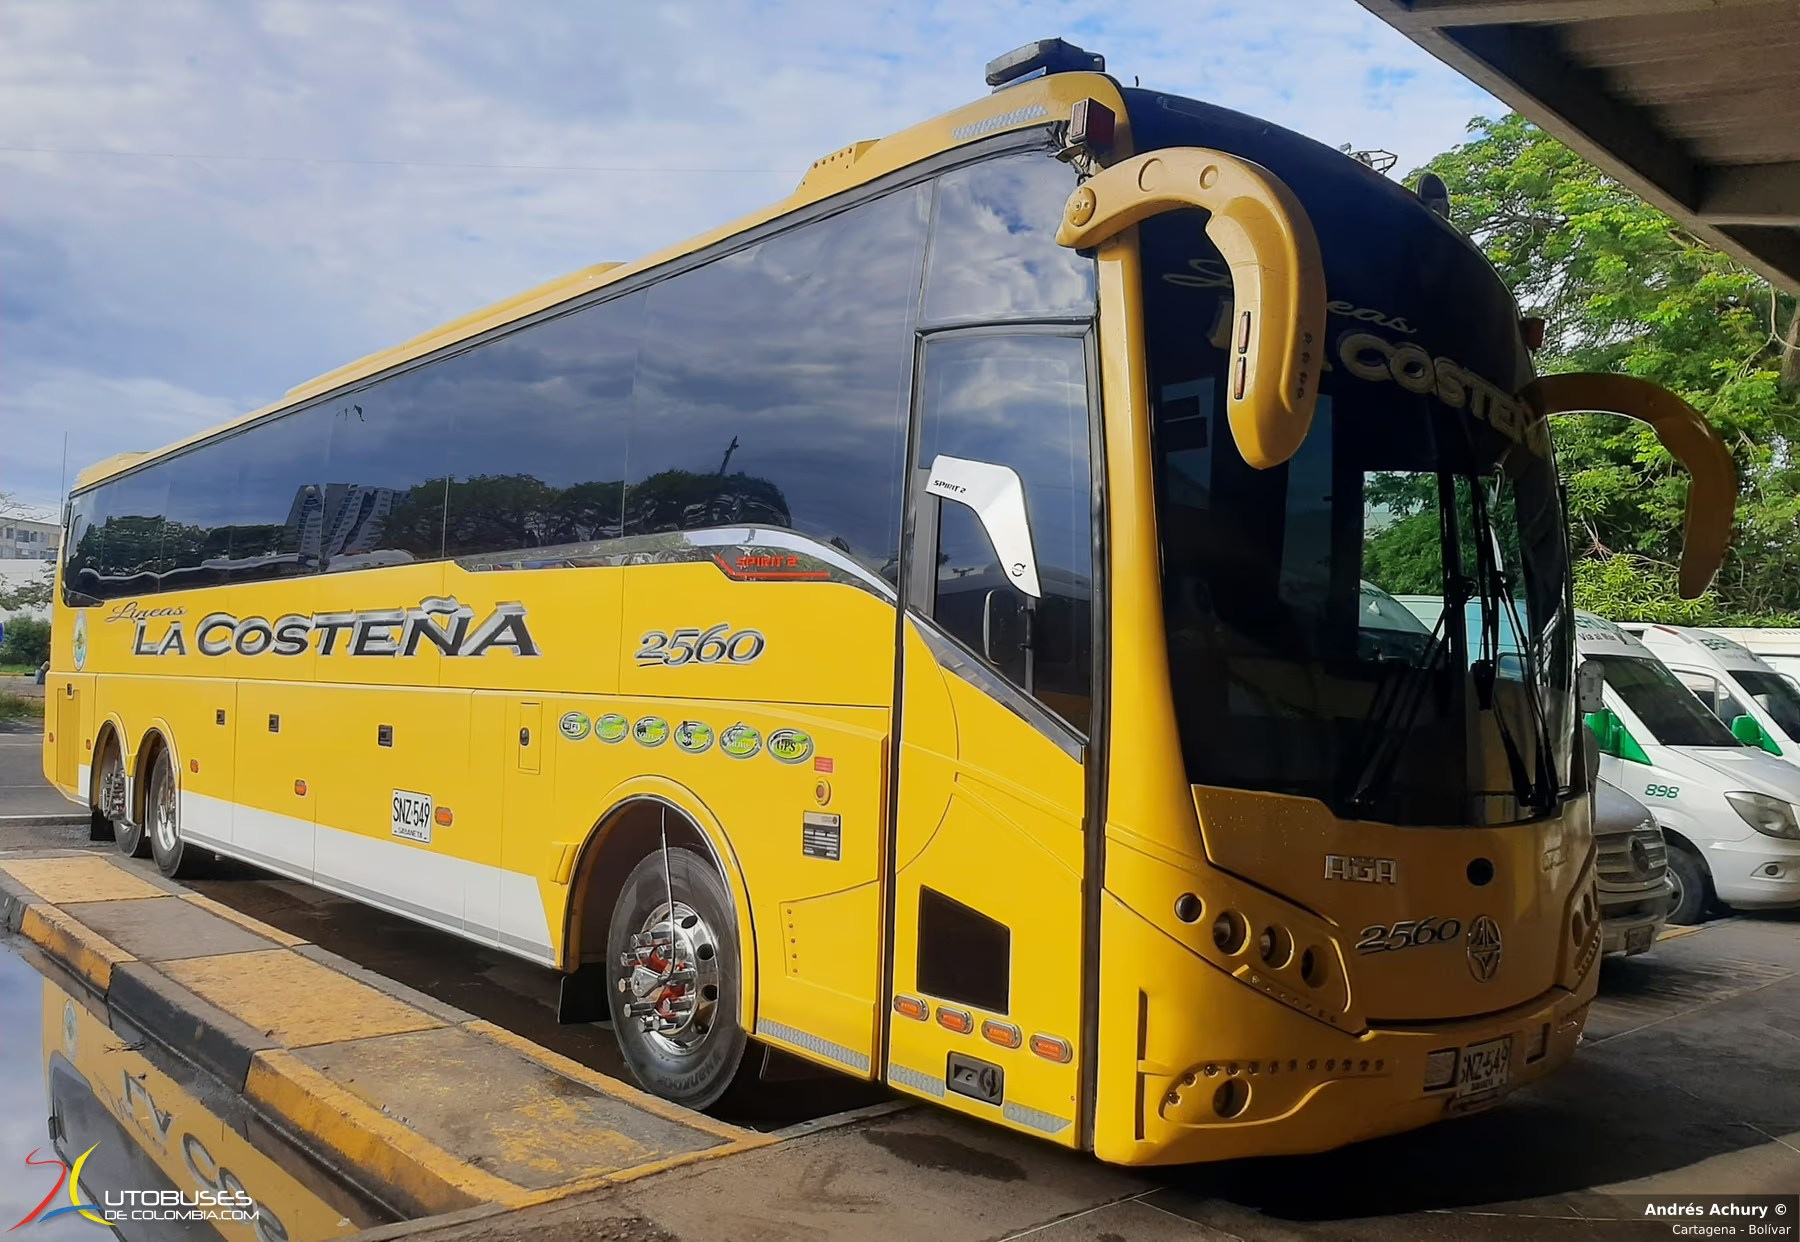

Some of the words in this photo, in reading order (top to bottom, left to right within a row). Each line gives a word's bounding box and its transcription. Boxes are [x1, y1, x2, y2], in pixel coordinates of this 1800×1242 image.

[933, 479, 960, 493] SPIRIT
[735, 556, 783, 568] SPIRIT
[131, 618, 187, 658] LA
[194, 595, 543, 659] COSTEÑA
[634, 622, 766, 666] 2560
[776, 738, 798, 753] GPS
[1644, 783, 1680, 799] 898
[1324, 854, 1398, 884] AGA
[1355, 916, 1462, 953] 2560
